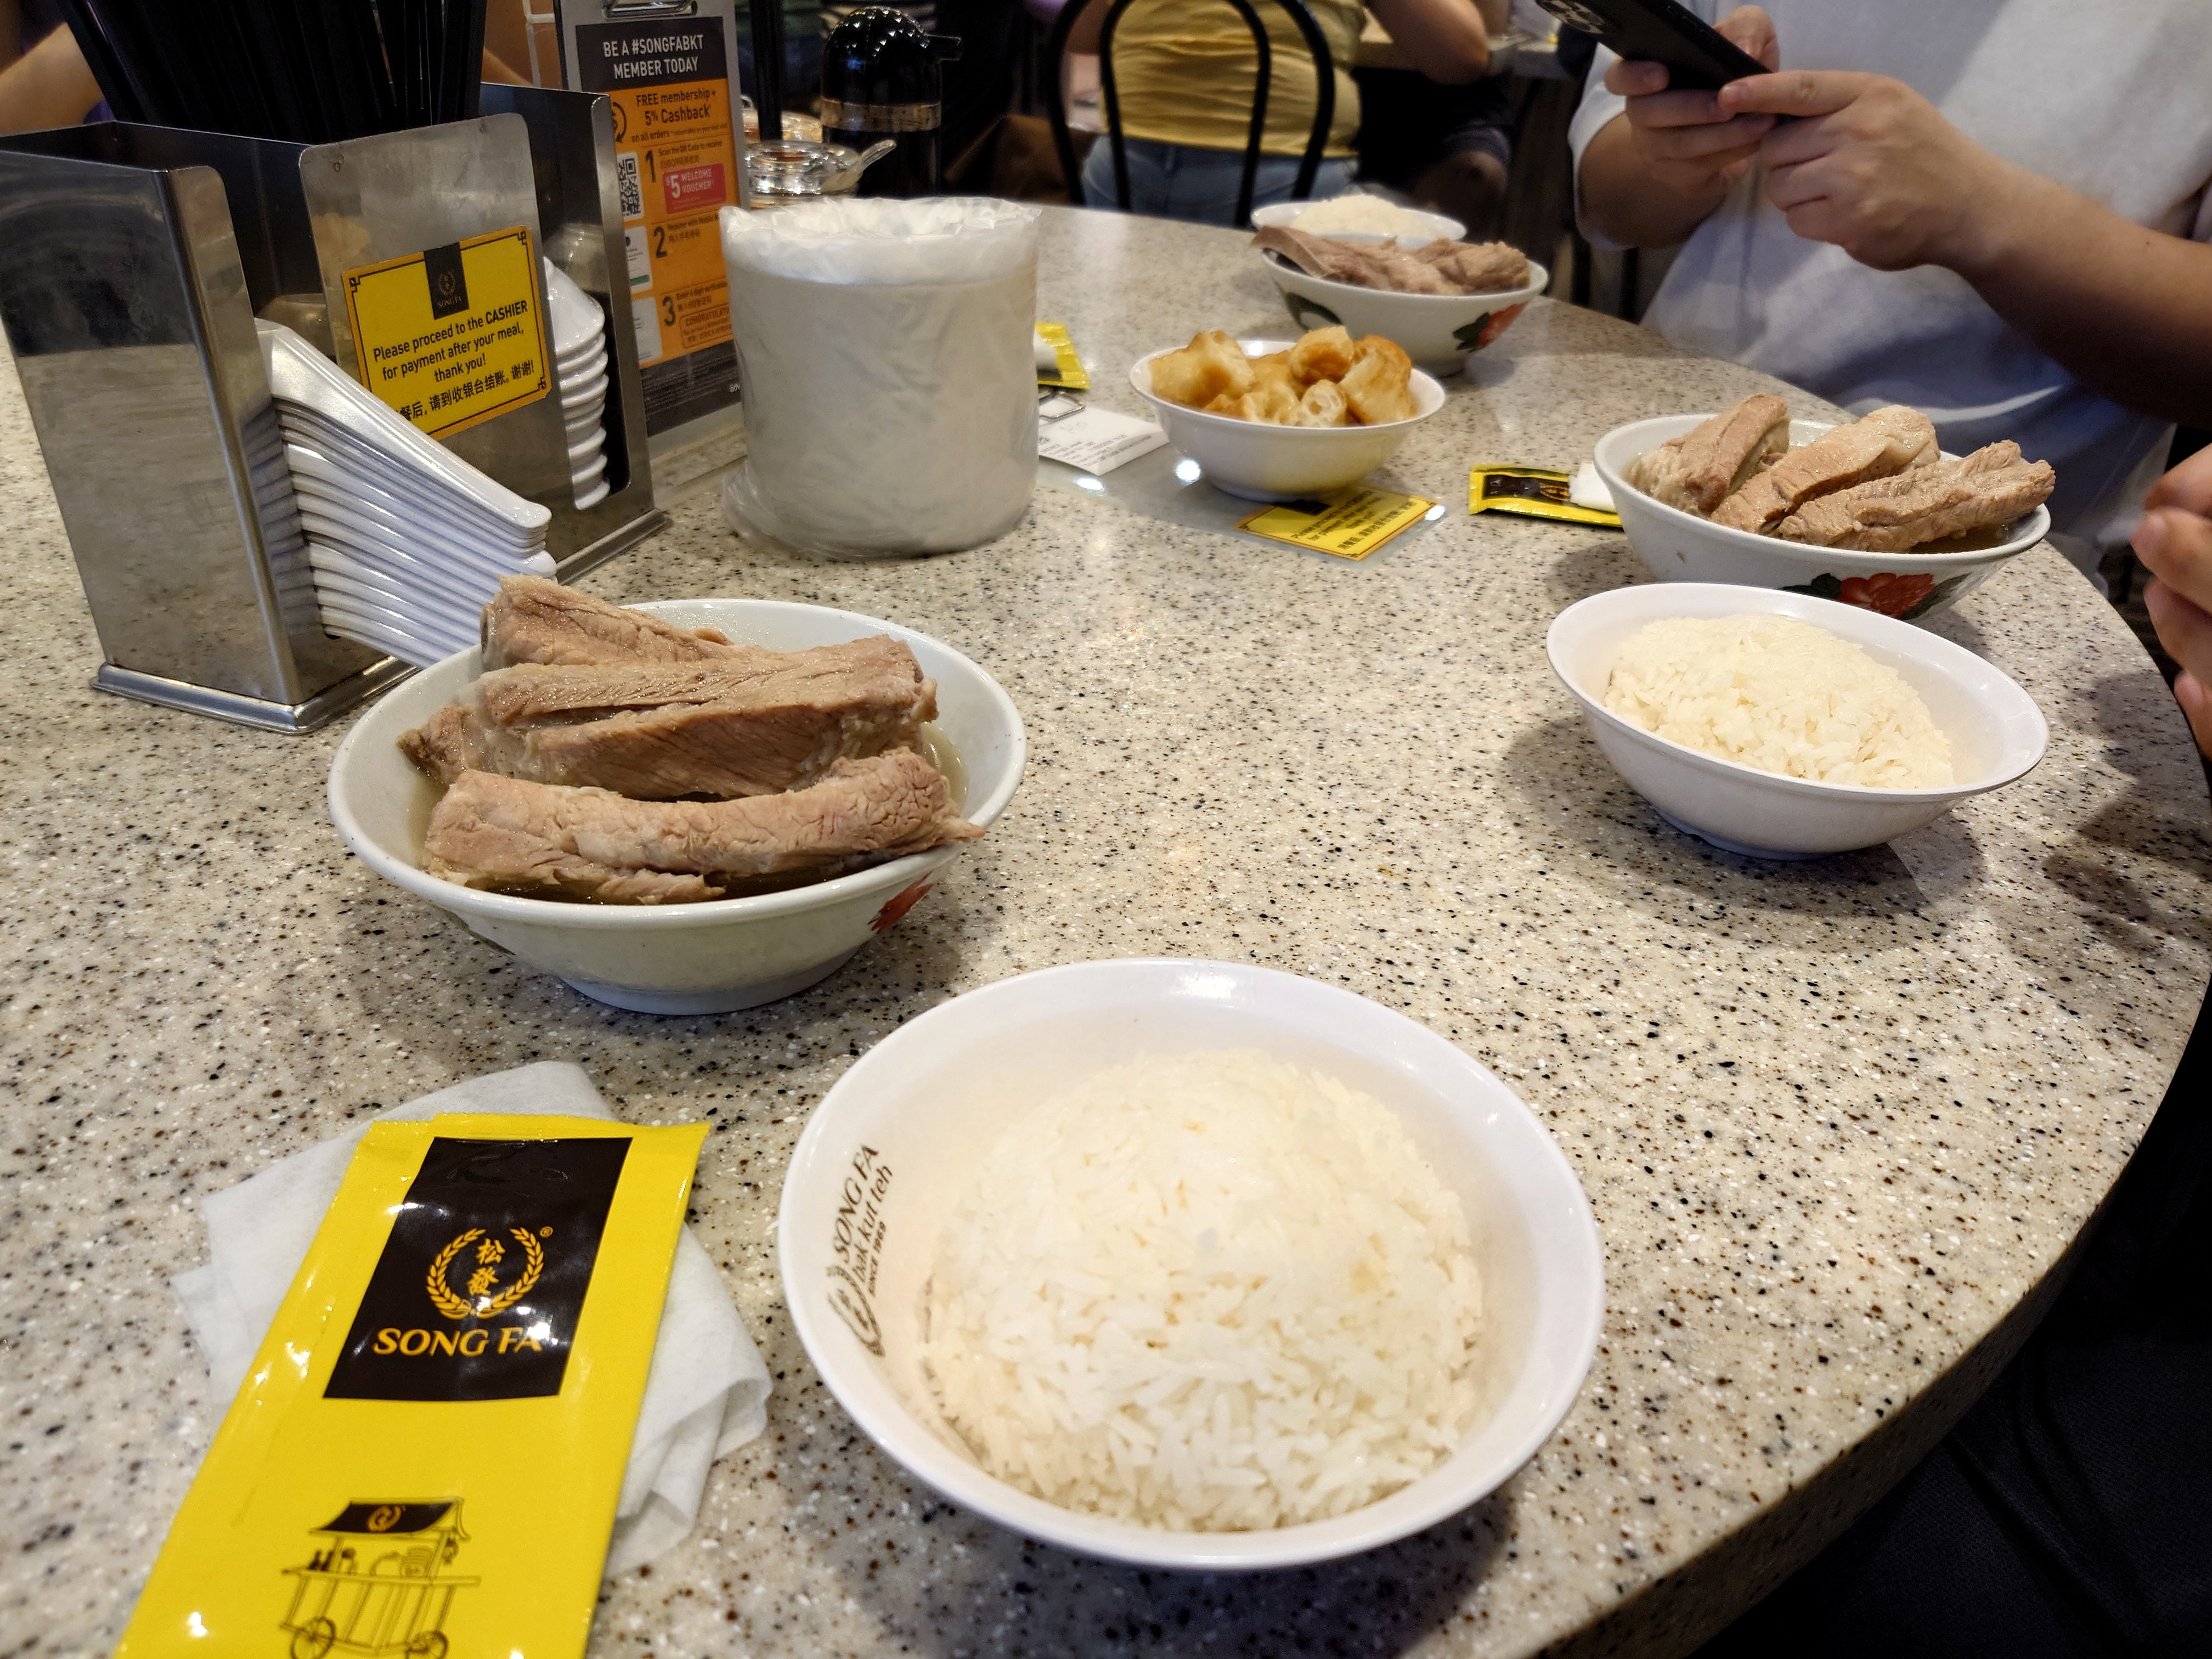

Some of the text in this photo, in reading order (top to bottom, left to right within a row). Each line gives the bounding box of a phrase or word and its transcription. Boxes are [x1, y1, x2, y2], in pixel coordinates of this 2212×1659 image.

[603, 34, 704, 58] BE A #SONGFABKT
[614, 57, 699, 80] MEMBER TODAY
[636, 93, 659, 108] FREE
[661, 88, 710, 104] membership
[645, 110, 659, 126] 5%
[641, 132, 649, 142] all
[650, 130, 670, 140] orders
[645, 150, 656, 183] 1
[681, 168, 712, 182] WELCOME
[682, 181, 712, 193] VOUCHER
[653, 225, 667, 258] 2
[662, 296, 676, 326] 3
[373, 300, 528, 362] Please proceed to the CASHIER
[382, 321, 524, 381] for payment after your meal,
[435, 352, 487, 383] thank you!
[870, 1165, 893, 1203] teh
[833, 1176, 862, 1263] SONG
[852, 1144, 879, 1181] FA
[857, 1200, 878, 1243] kut
[466, 1238, 506, 1297] 松發
[852, 1241, 869, 1283] bak
[868, 1220, 887, 1299] SINCE 1969
[373, 1327, 543, 1357] SONG FA
